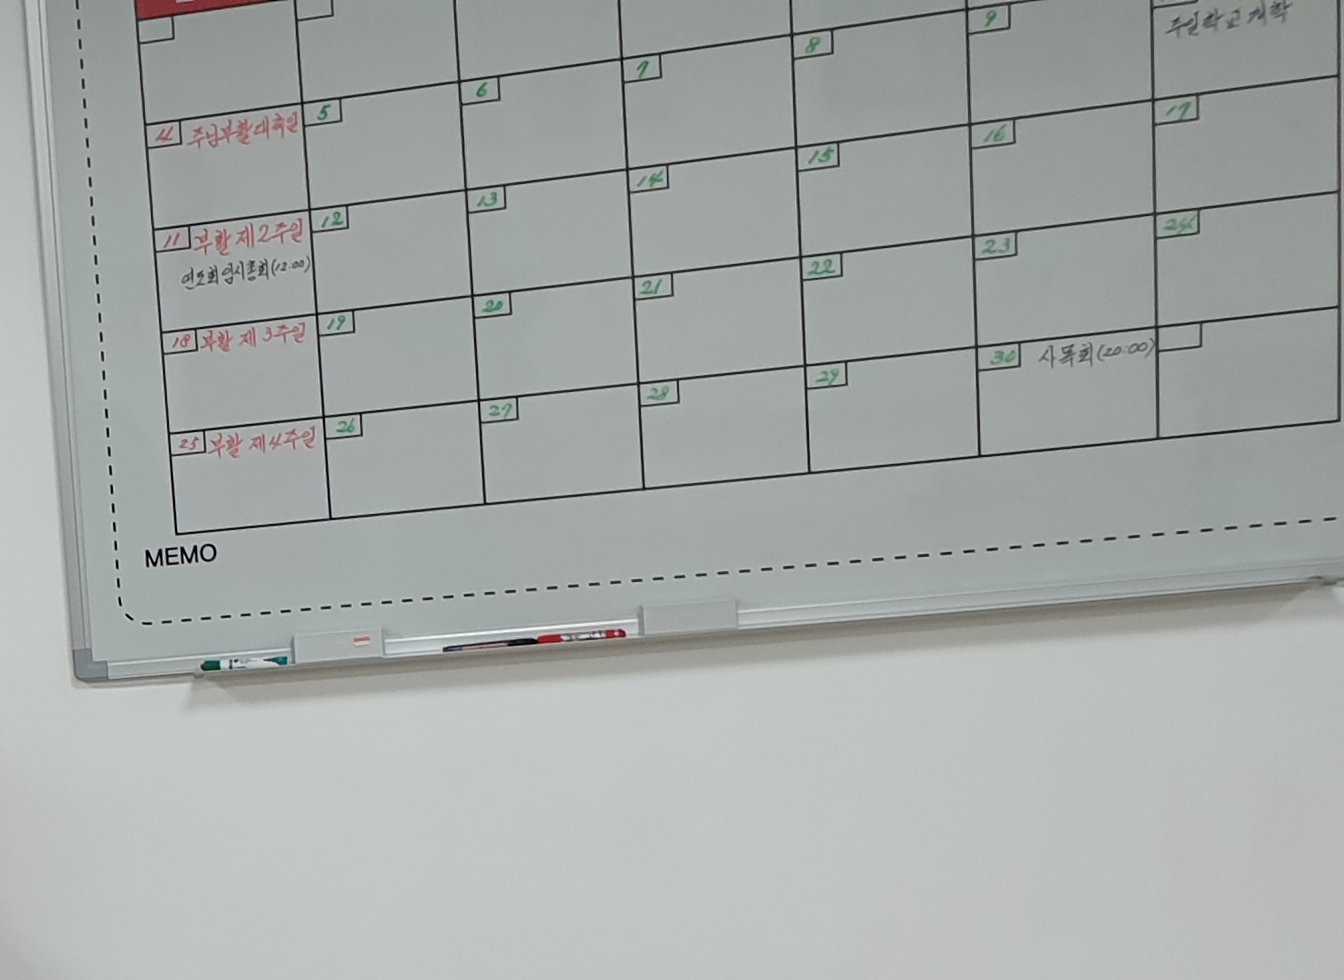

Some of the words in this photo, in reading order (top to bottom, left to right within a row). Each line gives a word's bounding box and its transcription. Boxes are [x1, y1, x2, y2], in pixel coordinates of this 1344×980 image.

[806, 36, 821, 55] 8
[475, 81, 488, 98] 6
[317, 104, 330, 121] 5
[983, 126, 1007, 144] 16
[807, 147, 834, 165] 15
[636, 171, 664, 188] 14
[477, 191, 498, 208] 13
[320, 212, 344, 229] 12
[164, 232, 180, 248] 11
[982, 238, 1011, 255] 23
[807, 259, 836, 276] 22
[641, 280, 663, 295] 21
[482, 299, 502, 313] 20
[326, 315, 346, 331] 19
[172, 334, 190, 347] 18
[990, 349, 1016, 366] 30
[646, 385, 670, 402] 28
[489, 403, 513, 419] 27
[335, 418, 356, 434] 26
[178, 437, 199, 449] 25
[145, 543, 218, 568] MEMO
